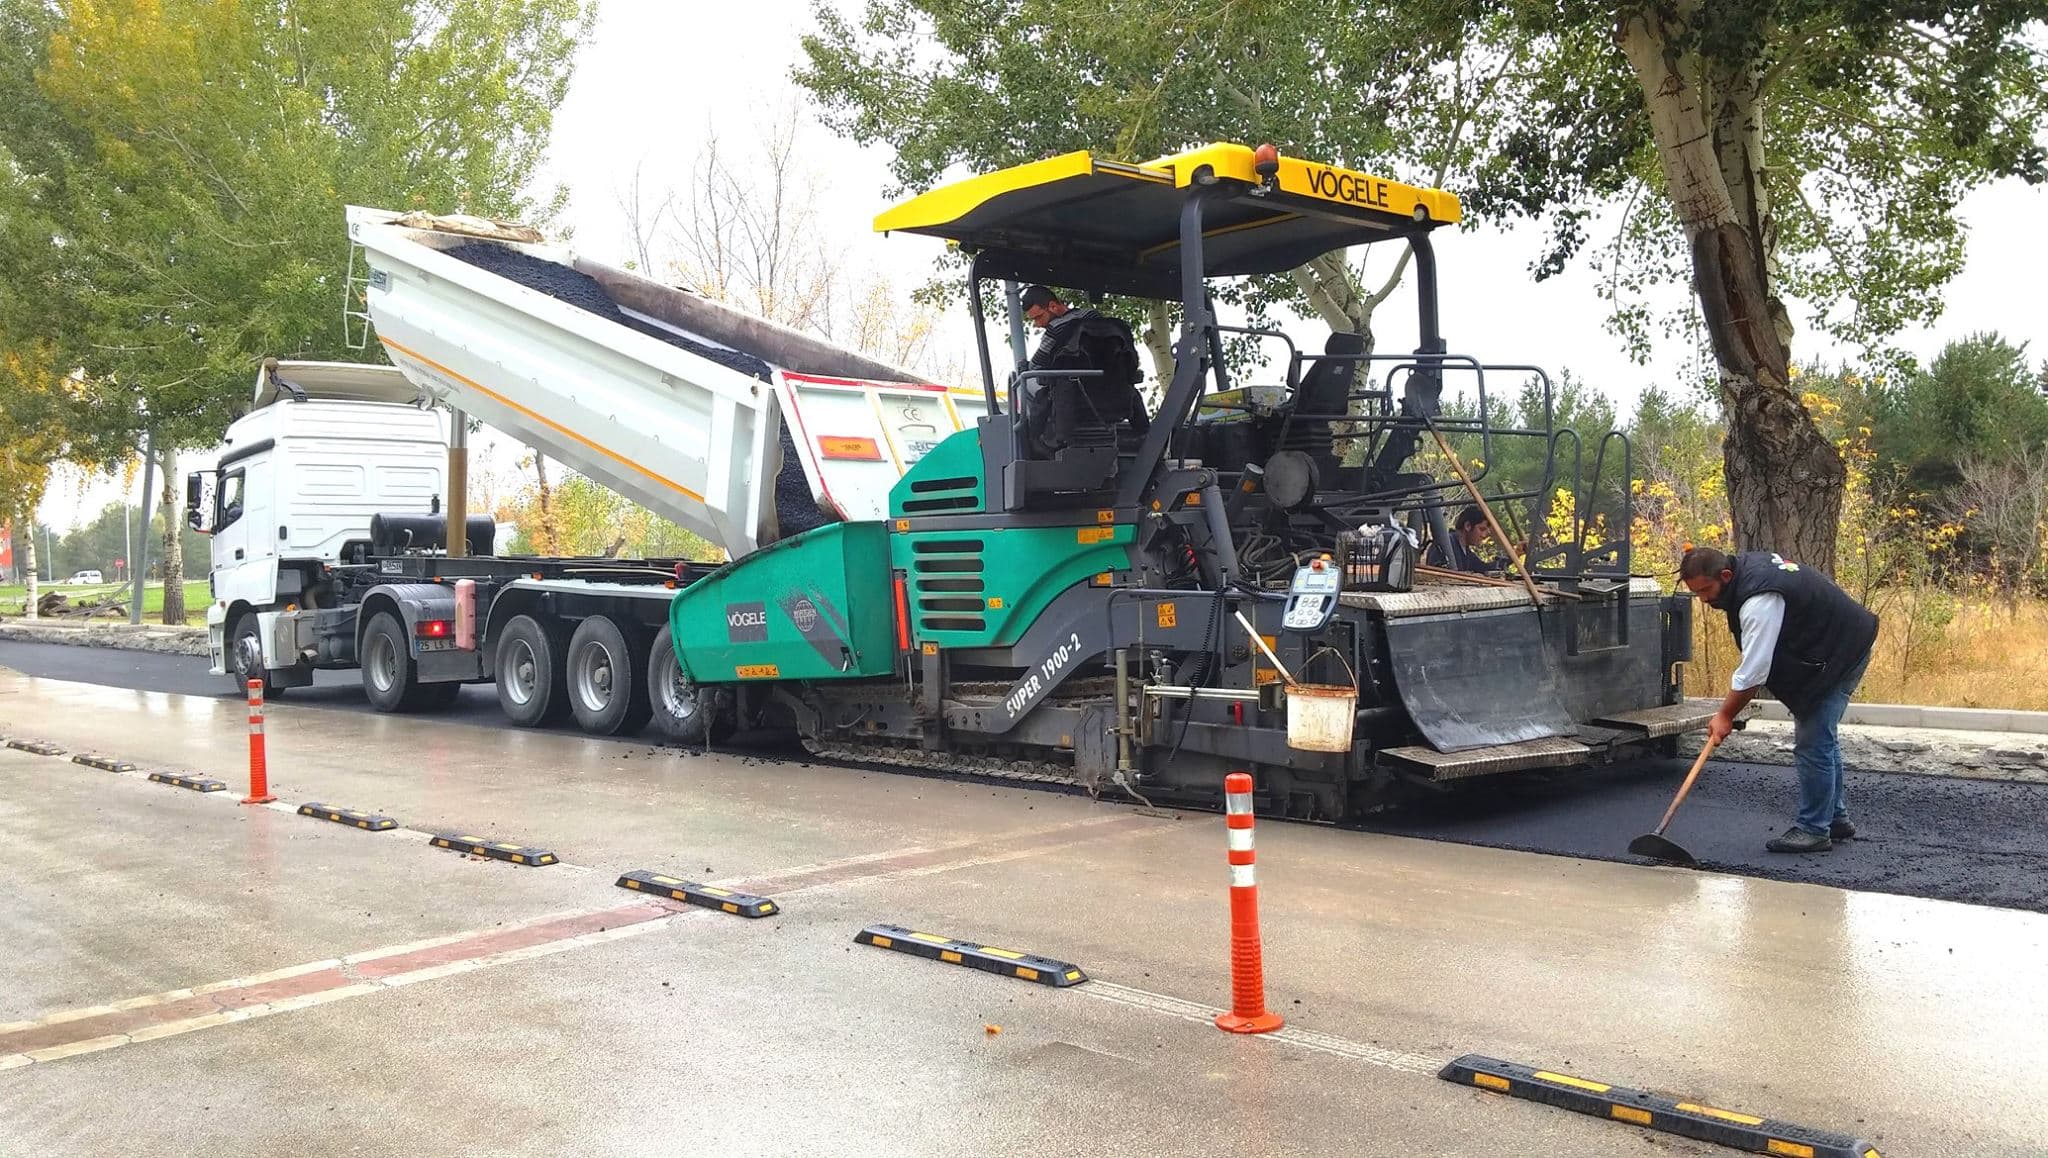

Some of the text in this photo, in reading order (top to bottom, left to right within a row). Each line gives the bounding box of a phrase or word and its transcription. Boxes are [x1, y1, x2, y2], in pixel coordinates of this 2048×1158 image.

[1306, 166, 1389, 208] VÖGELE
[727, 611, 767, 627] VÖGELE
[1006, 632, 1082, 718] SUPER 1900-2
